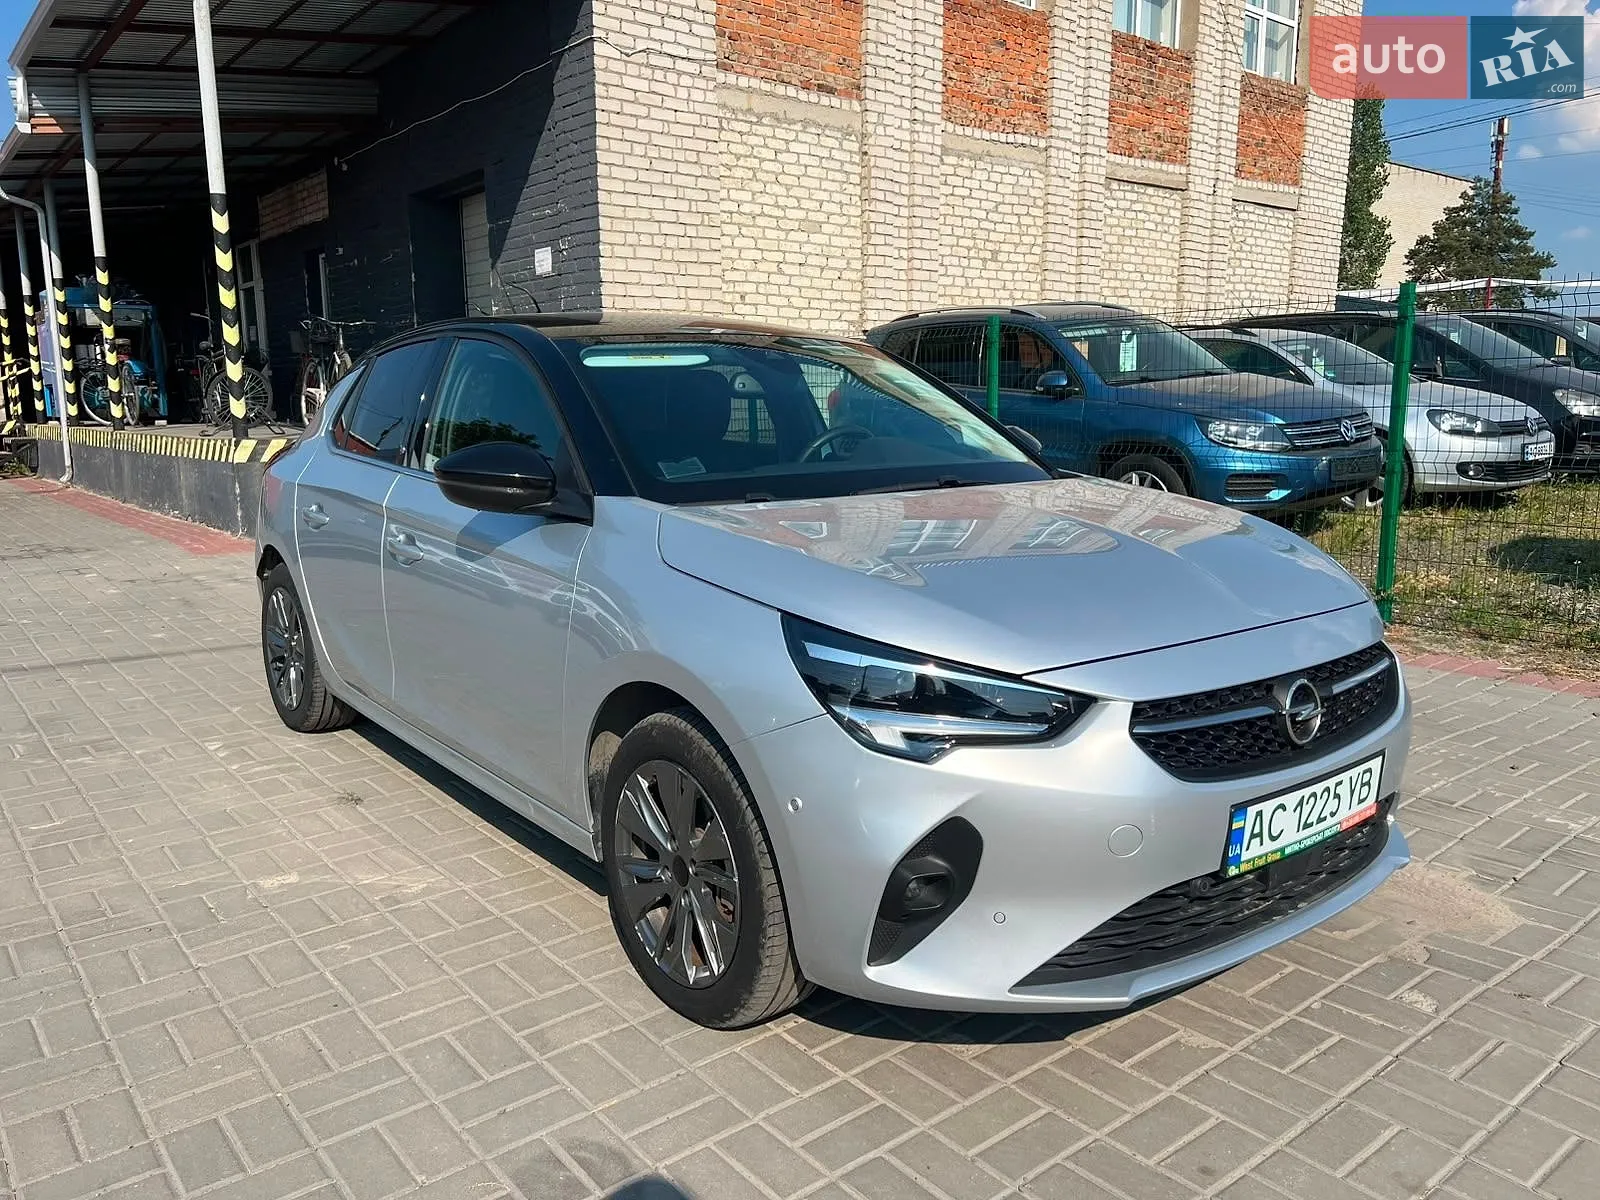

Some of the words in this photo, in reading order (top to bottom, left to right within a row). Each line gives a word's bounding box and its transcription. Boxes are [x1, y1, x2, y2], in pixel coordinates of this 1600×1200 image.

[1245, 803, 1287, 851] AC
[1292, 779, 1344, 833] 1225
[1348, 767, 1373, 810] YB
[1228, 843, 1241, 857] UA
